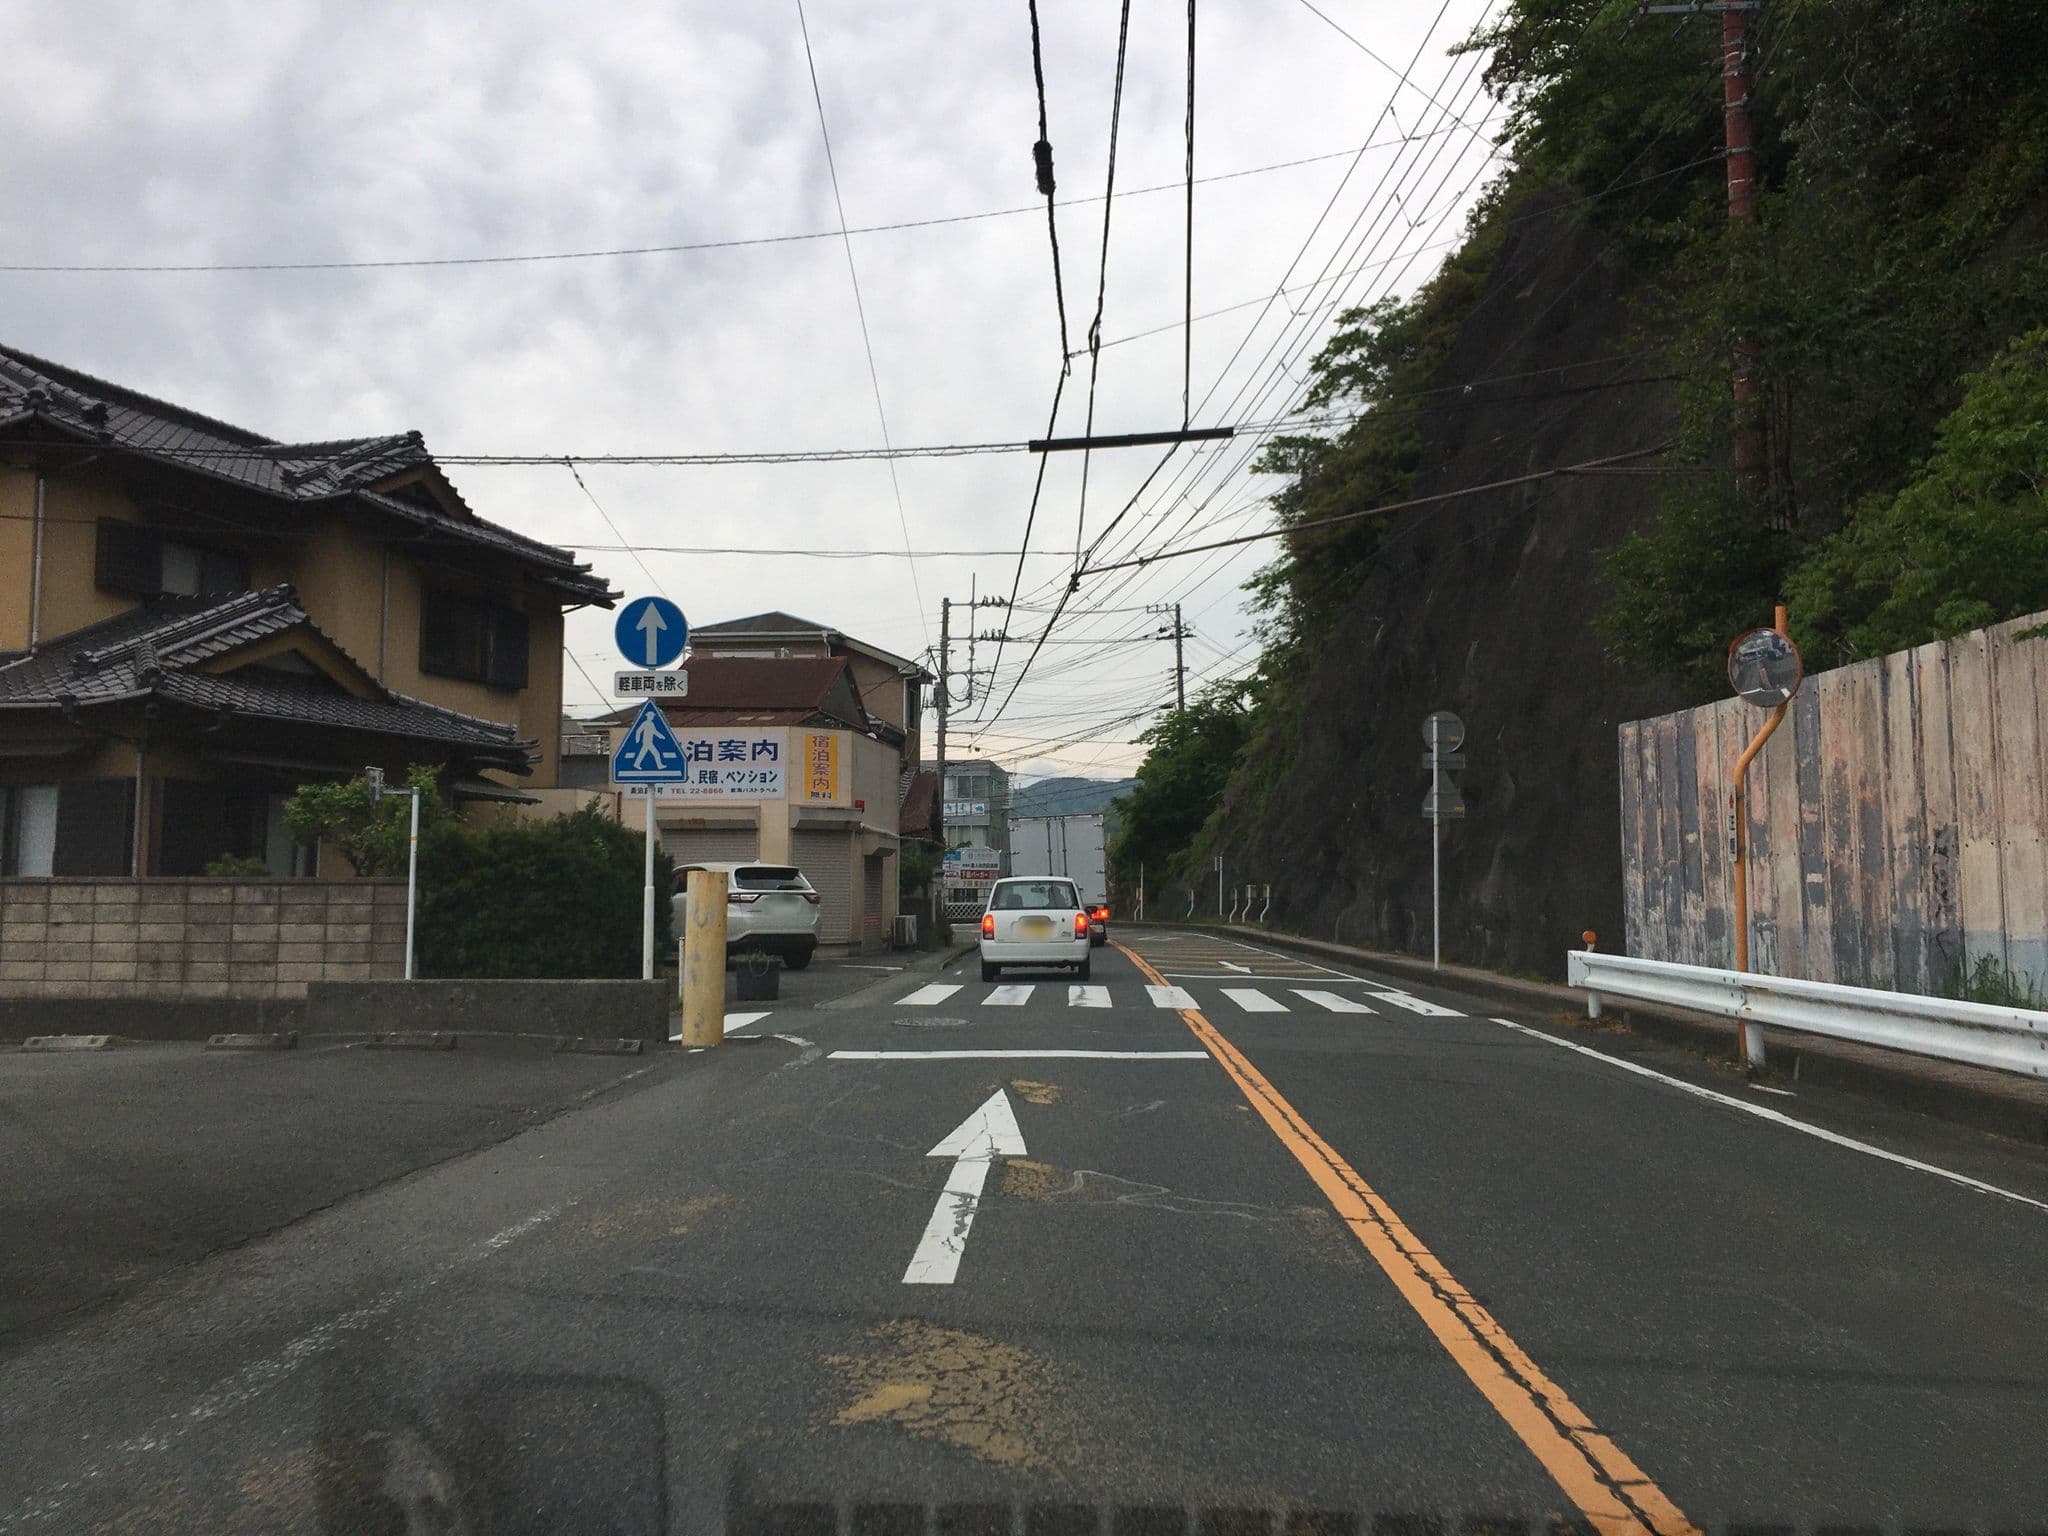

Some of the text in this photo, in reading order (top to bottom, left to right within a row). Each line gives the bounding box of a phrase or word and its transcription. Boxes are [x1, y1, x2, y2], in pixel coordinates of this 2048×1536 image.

[618, 676, 684, 691] 軽車両を除く
[680, 739, 779, 762] 泊案内
[812, 735, 830, 789] 宿泊案内
